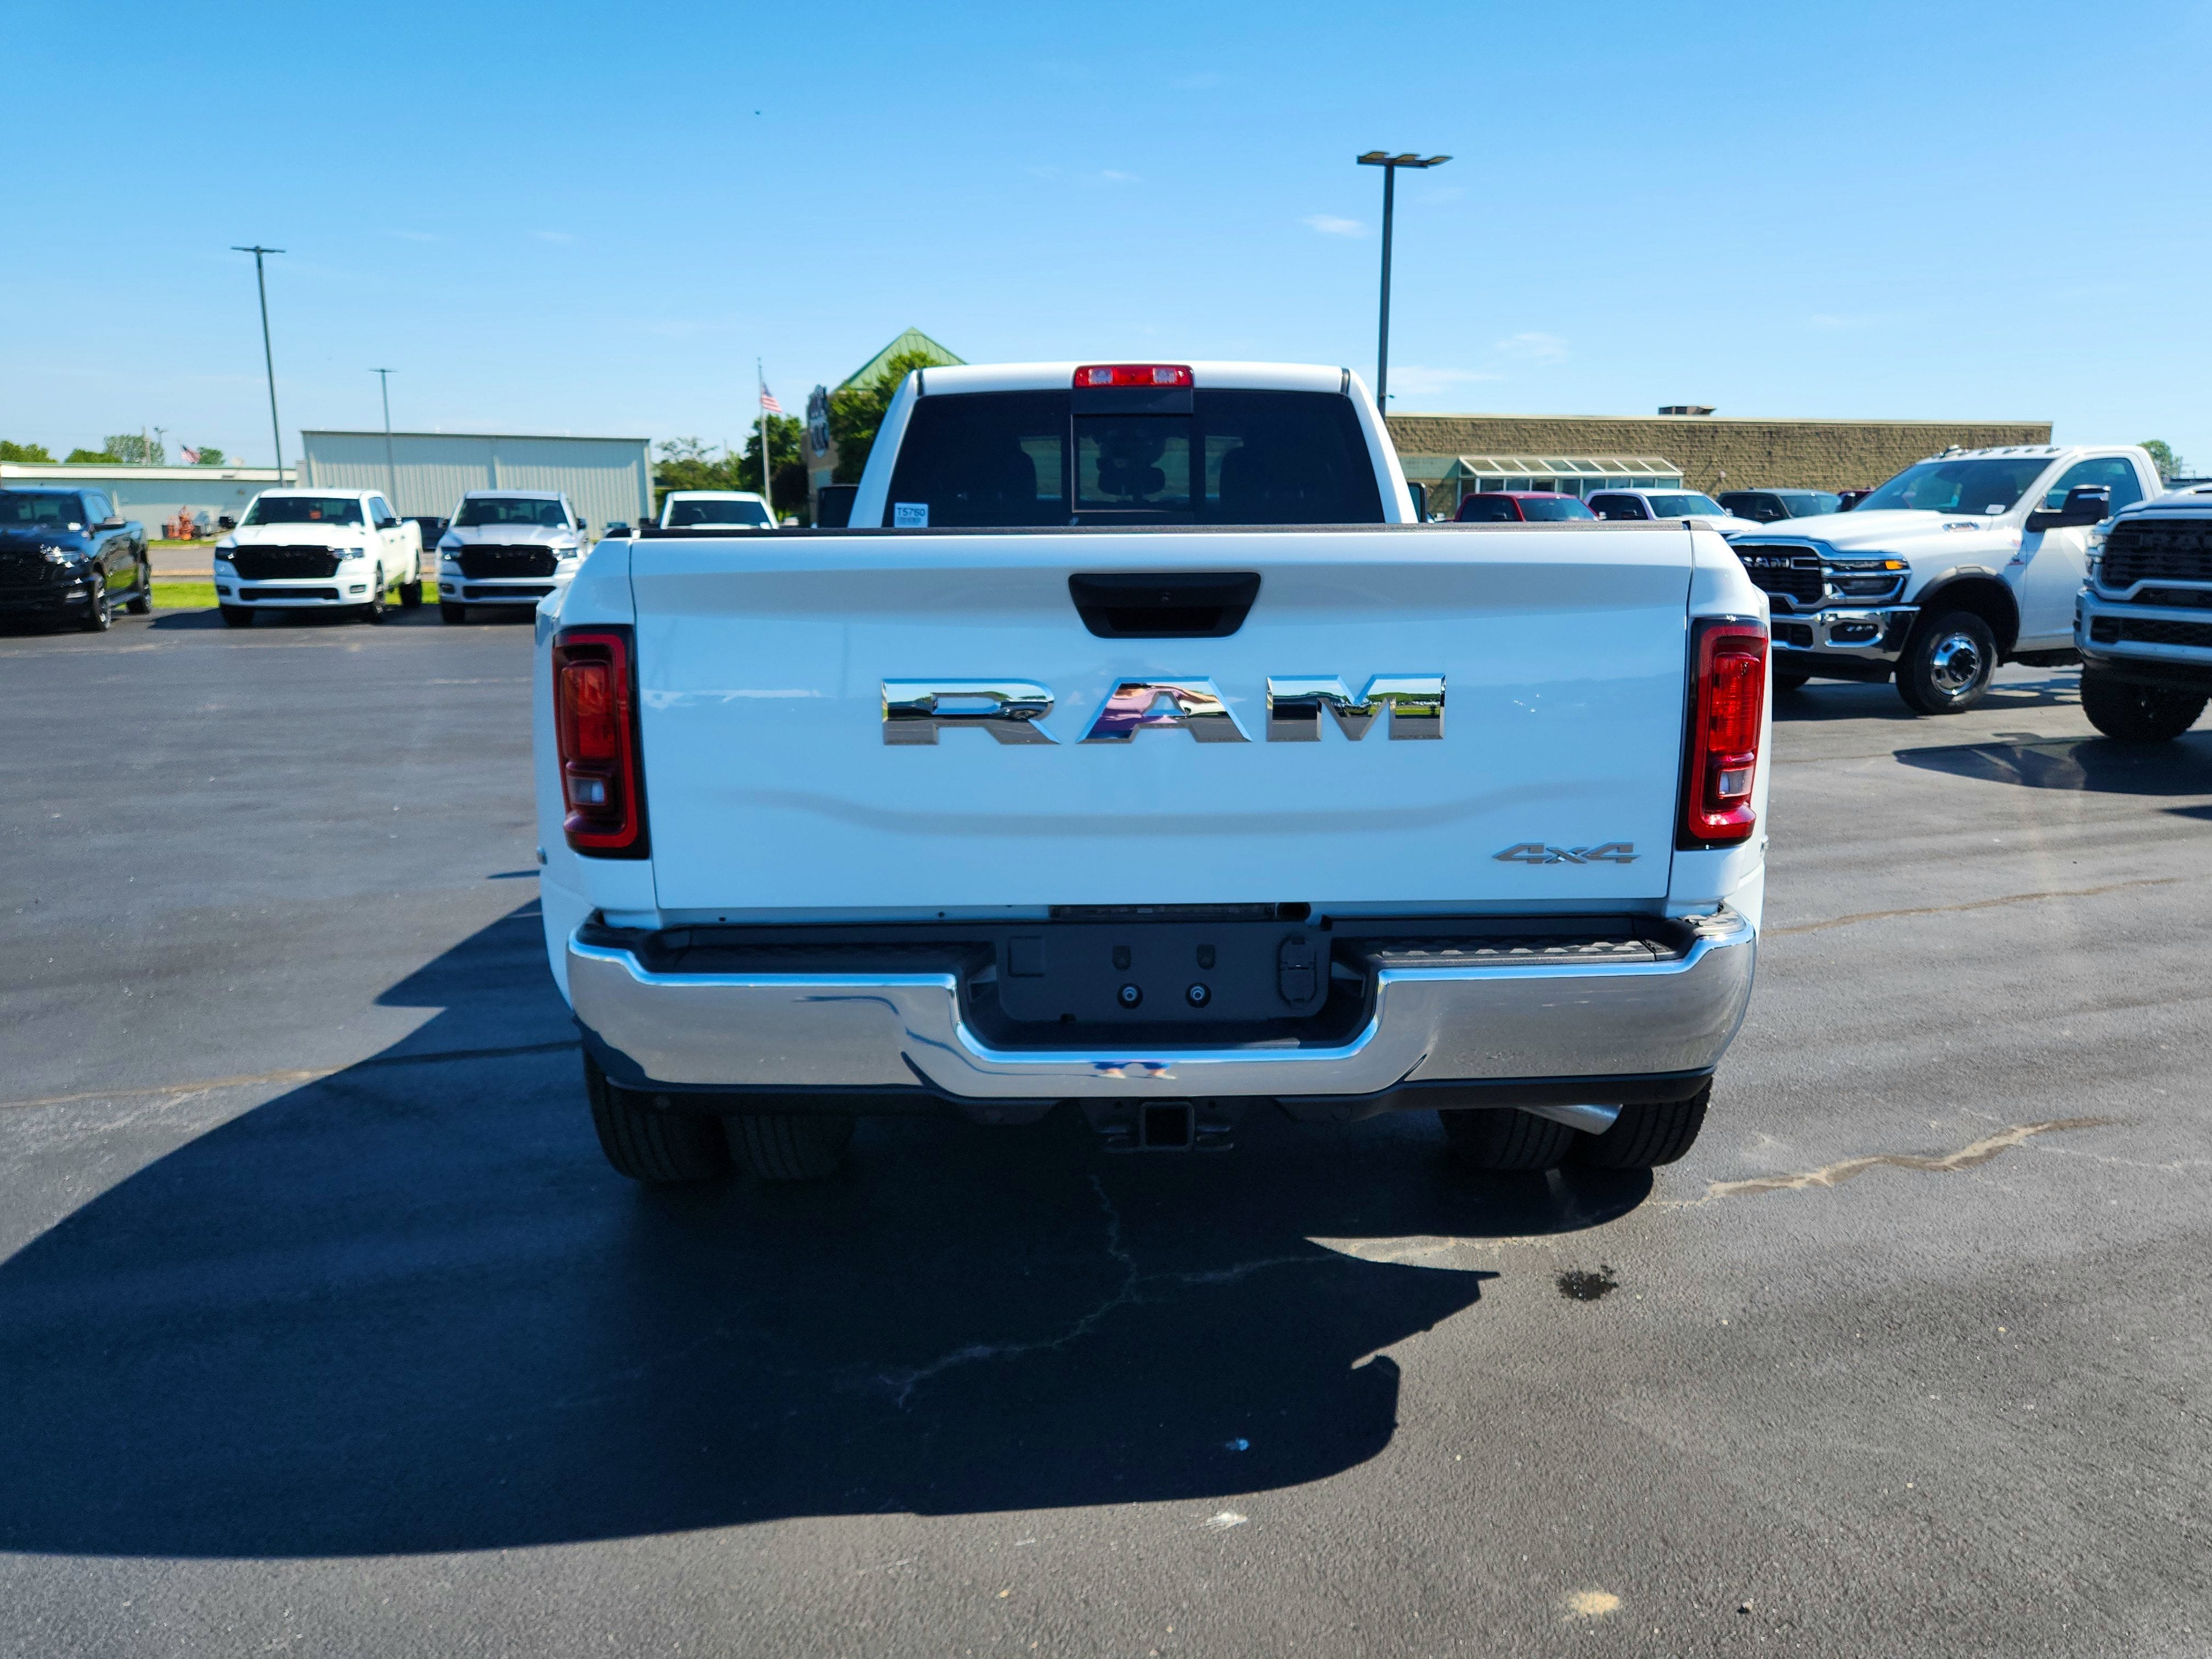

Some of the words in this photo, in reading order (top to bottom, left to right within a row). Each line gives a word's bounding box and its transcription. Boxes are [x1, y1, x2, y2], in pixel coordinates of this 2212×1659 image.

[897, 507, 926, 517] T5760
[882, 674, 1446, 746] RAM
[1492, 842, 1641, 864] 4x4
